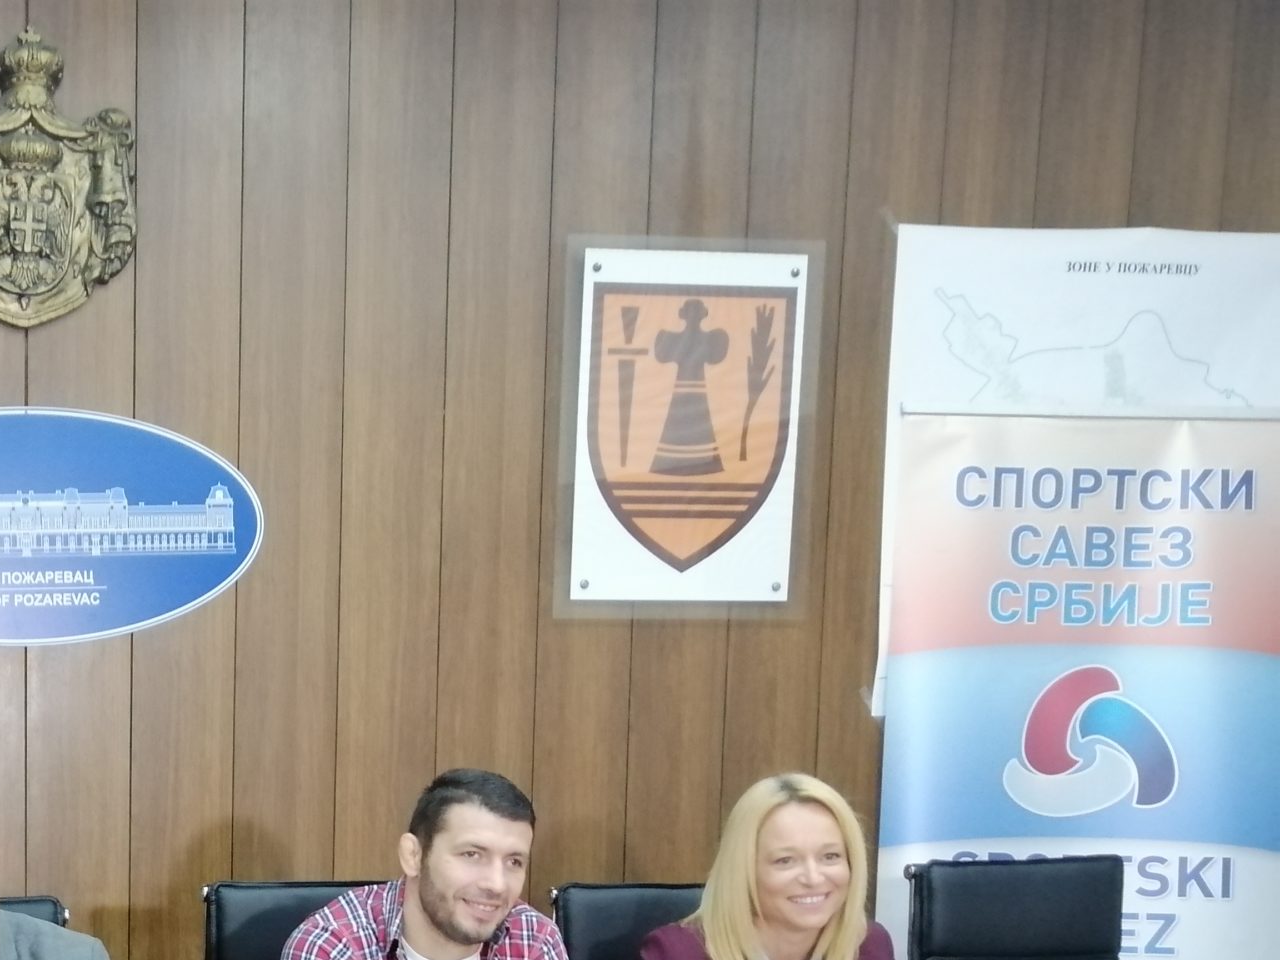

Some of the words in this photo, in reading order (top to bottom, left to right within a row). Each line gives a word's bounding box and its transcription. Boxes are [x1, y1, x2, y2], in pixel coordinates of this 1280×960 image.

[1066, 261, 1101, 273] ЗОНЕ
[1105, 261, 1115, 273] У
[1117, 261, 1202, 275] ПОЖАРЕВЦУ
[956, 466, 1255, 511] СПОРТСКИ
[1010, 523, 1194, 568] САВЕЗ
[1, 570, 95, 585] ПОЖАРЕВАЦ
[14, 592, 101, 607] POZAREVAC
[989, 580, 1213, 626] СРБИЈЕ
